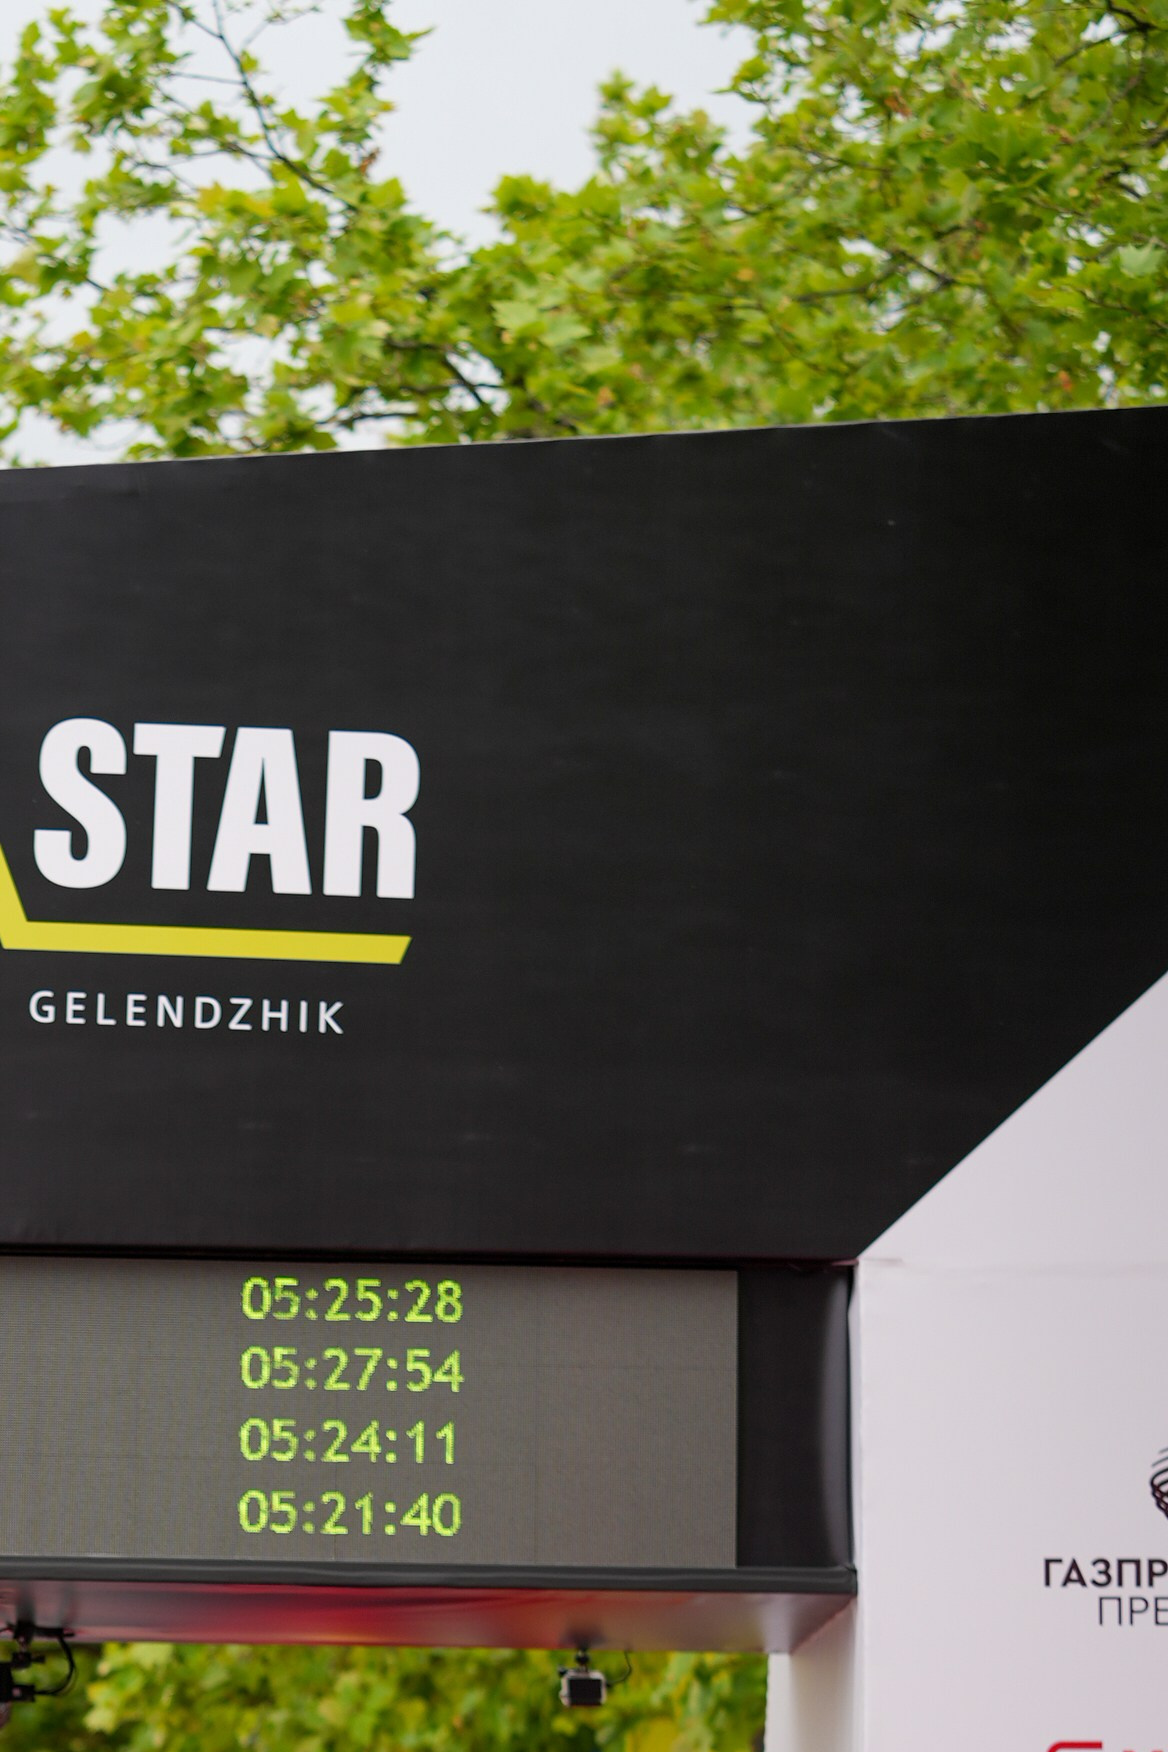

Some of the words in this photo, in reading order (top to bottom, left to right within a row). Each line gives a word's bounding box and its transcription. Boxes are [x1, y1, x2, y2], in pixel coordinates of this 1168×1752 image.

[34, 718, 420, 899] STAR
[29, 990, 344, 1034] GELENDZHIK
[241, 1275, 464, 1322] 05:25:28
[240, 1346, 464, 1392] 05:27:54
[239, 1417, 455, 1463] 05:24:11
[238, 1489, 462, 1536] 05:21:40
[1044, 1557, 1168, 1588] ГАЗПР
[1098, 1596, 1168, 1626] ПРЕ
